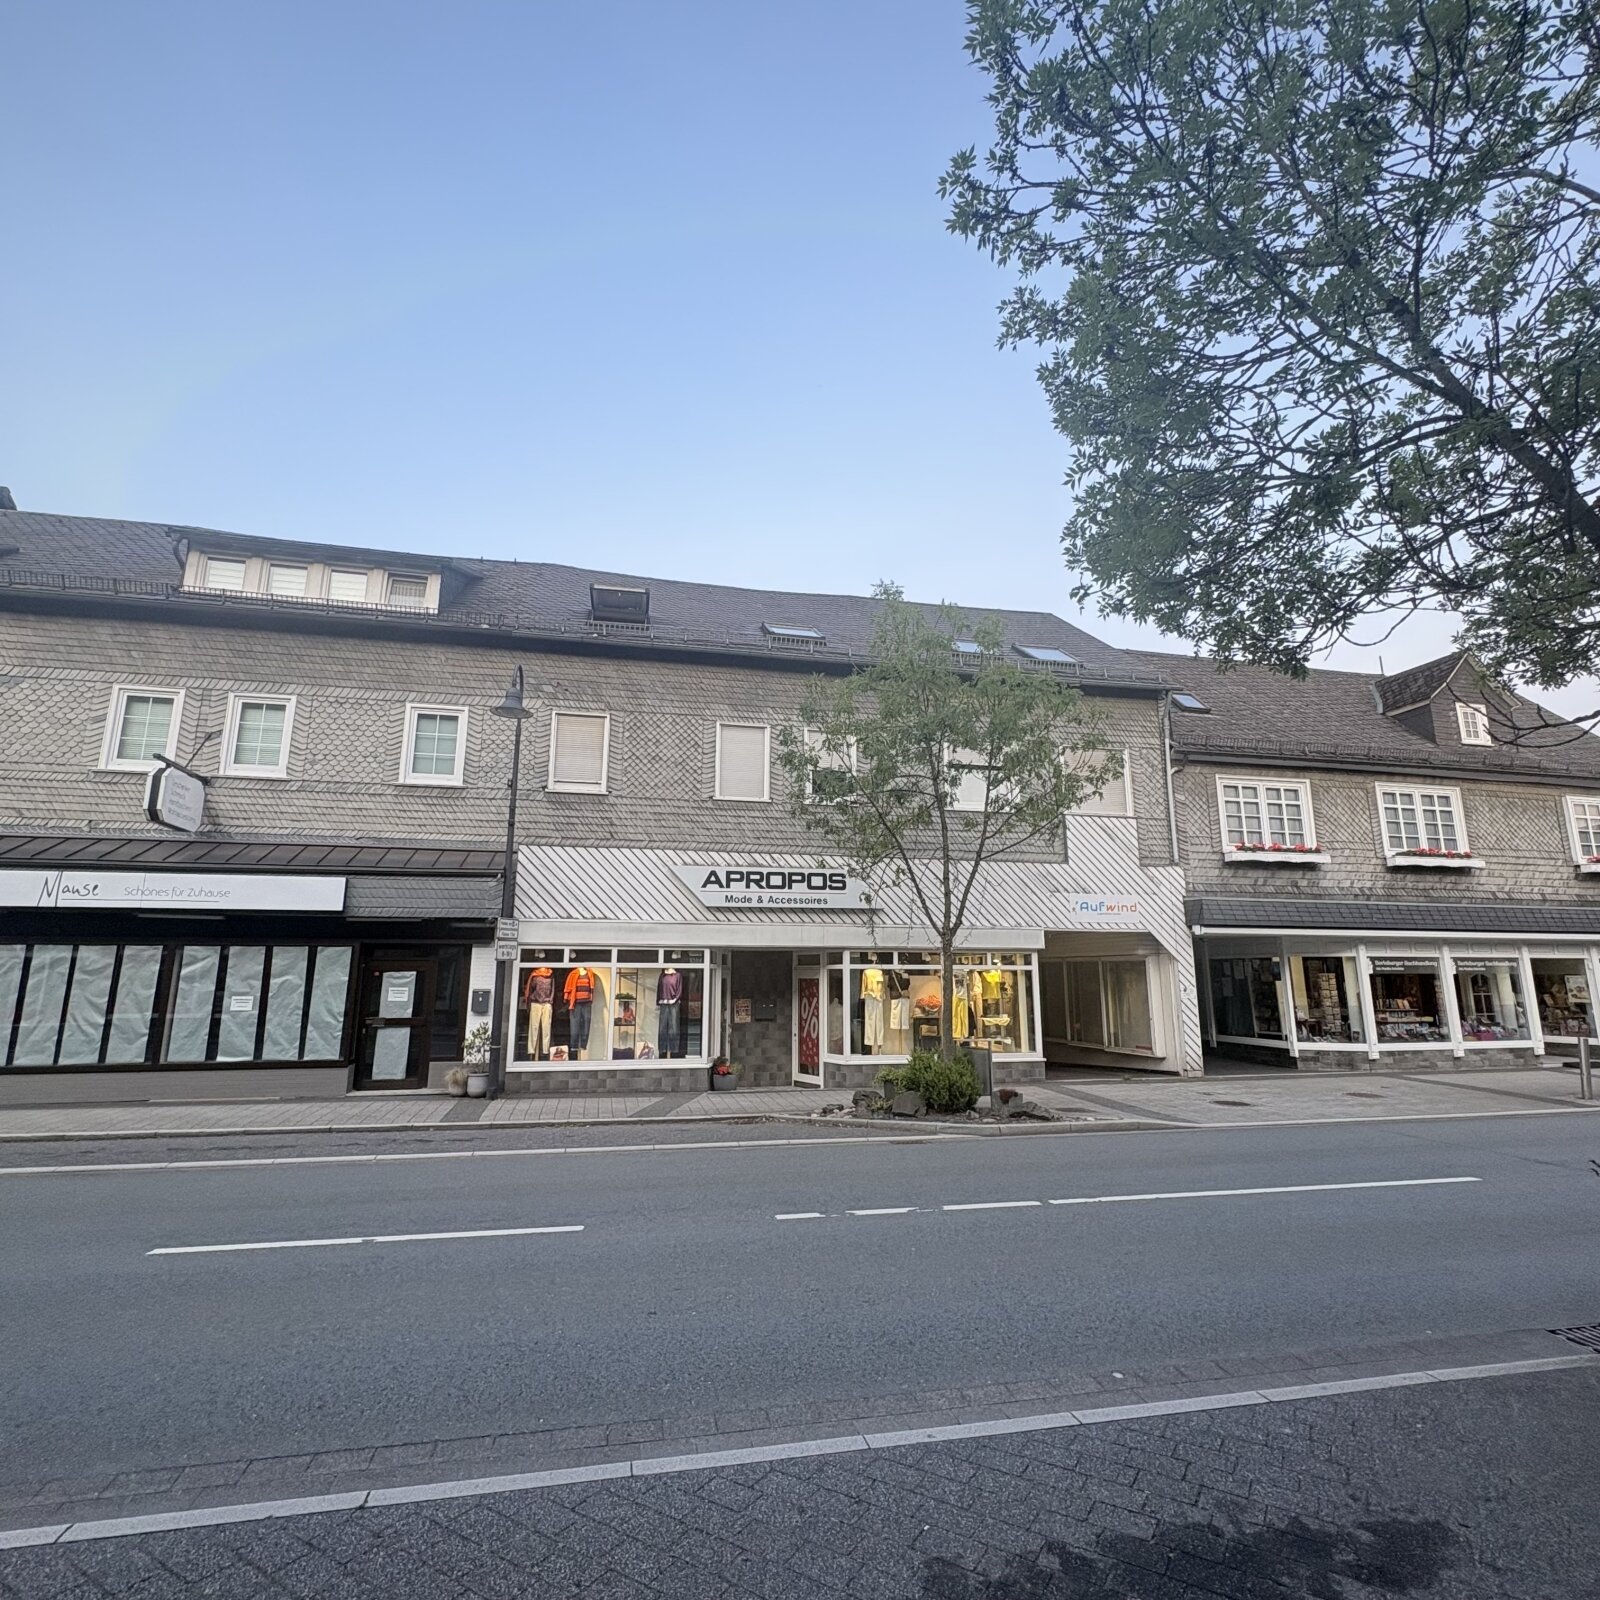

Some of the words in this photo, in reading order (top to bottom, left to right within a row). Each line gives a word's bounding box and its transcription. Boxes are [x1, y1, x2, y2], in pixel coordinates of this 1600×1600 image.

[701, 870, 847, 891] APROPOS
[37, 871, 99, 907] Mause
[124, 886, 169, 897] Schönes
[171, 886, 186, 899] für
[187, 887, 231, 898] Zuhause
[725, 895, 753, 904] Mode
[756, 895, 764, 904] &
[767, 895, 829, 905] Accessoires
[1080, 901, 1137, 912] Aufwind
